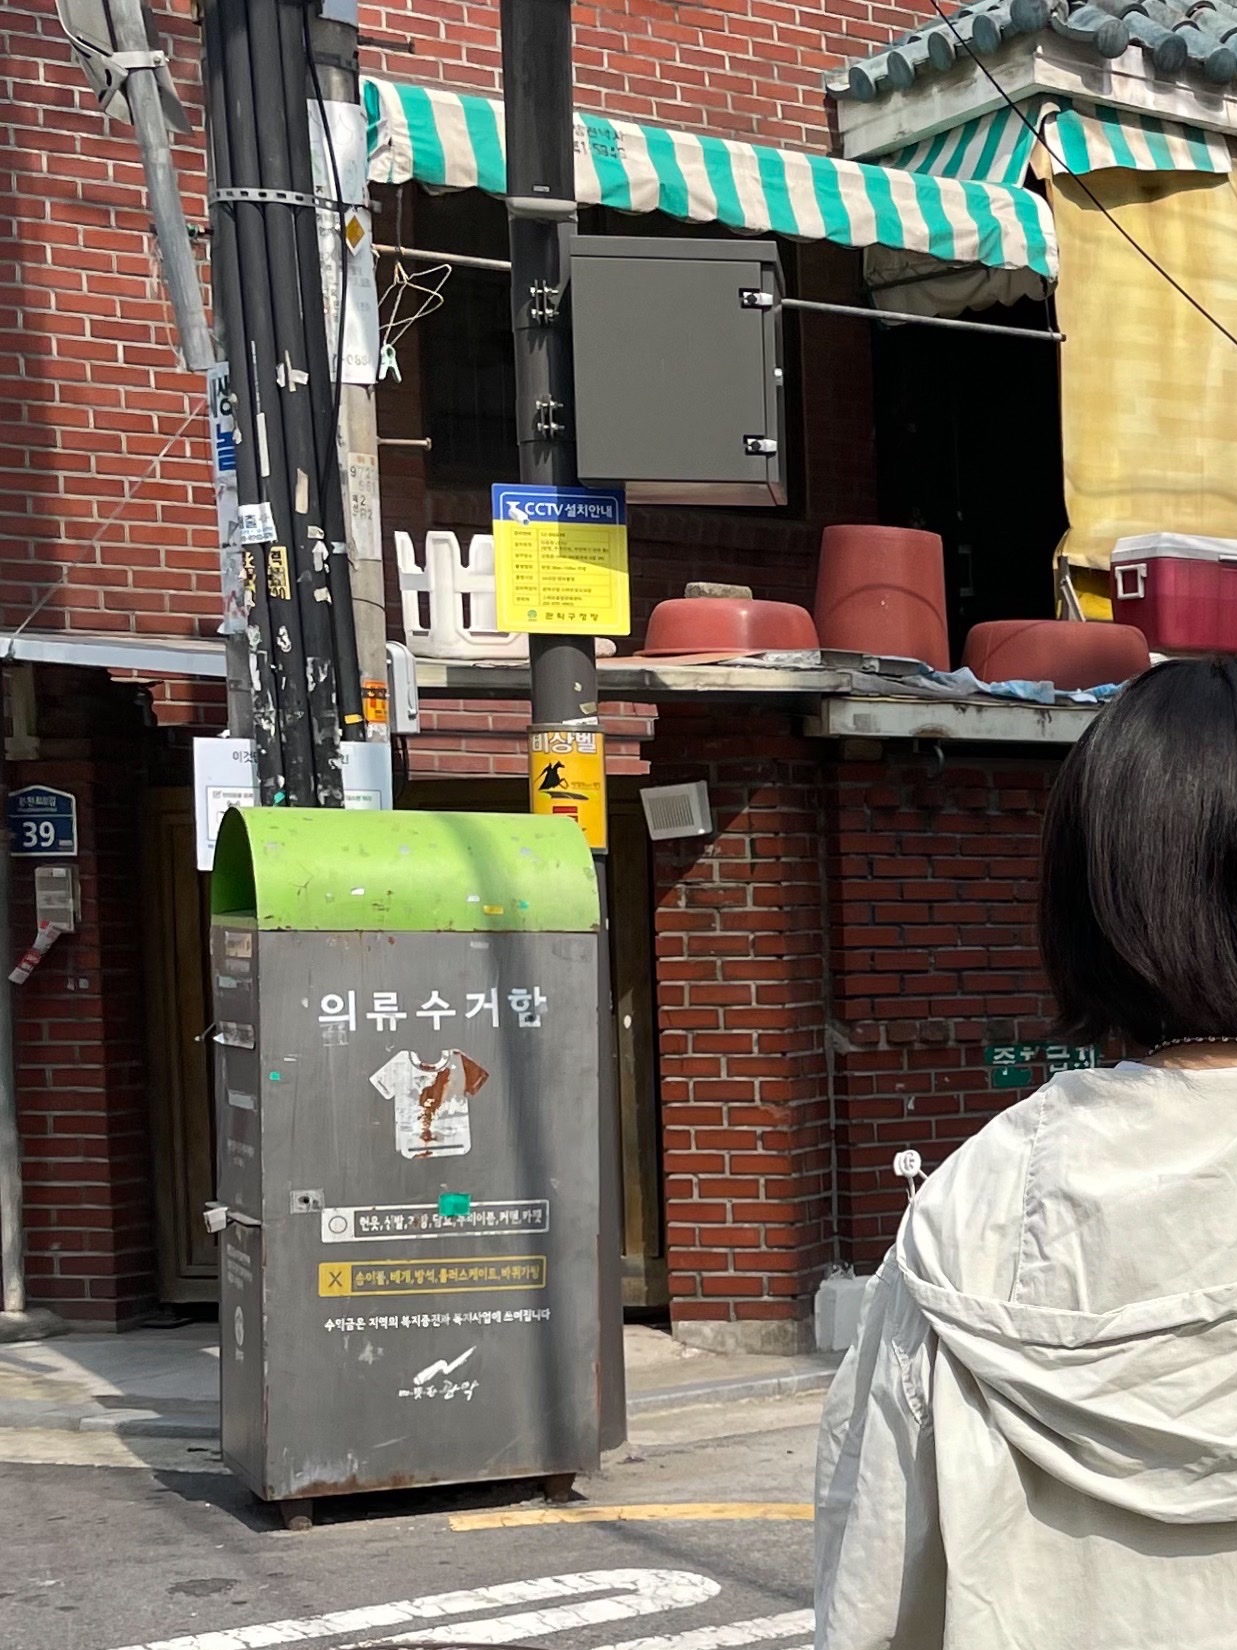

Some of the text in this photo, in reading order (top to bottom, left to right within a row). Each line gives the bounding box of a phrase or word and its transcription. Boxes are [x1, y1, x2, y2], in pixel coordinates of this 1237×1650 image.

[525, 502, 613, 518] CCTV 설치안내
[532, 732, 597, 754] 비상벨
[22, 820, 55, 848] 39
[318, 986, 547, 1032] 의류수거함
[324, 1317, 366, 1332] 수익금은
[368, 1315, 399, 1330] 지역의
[503, 1308, 551, 1322] 쓰여집니다
